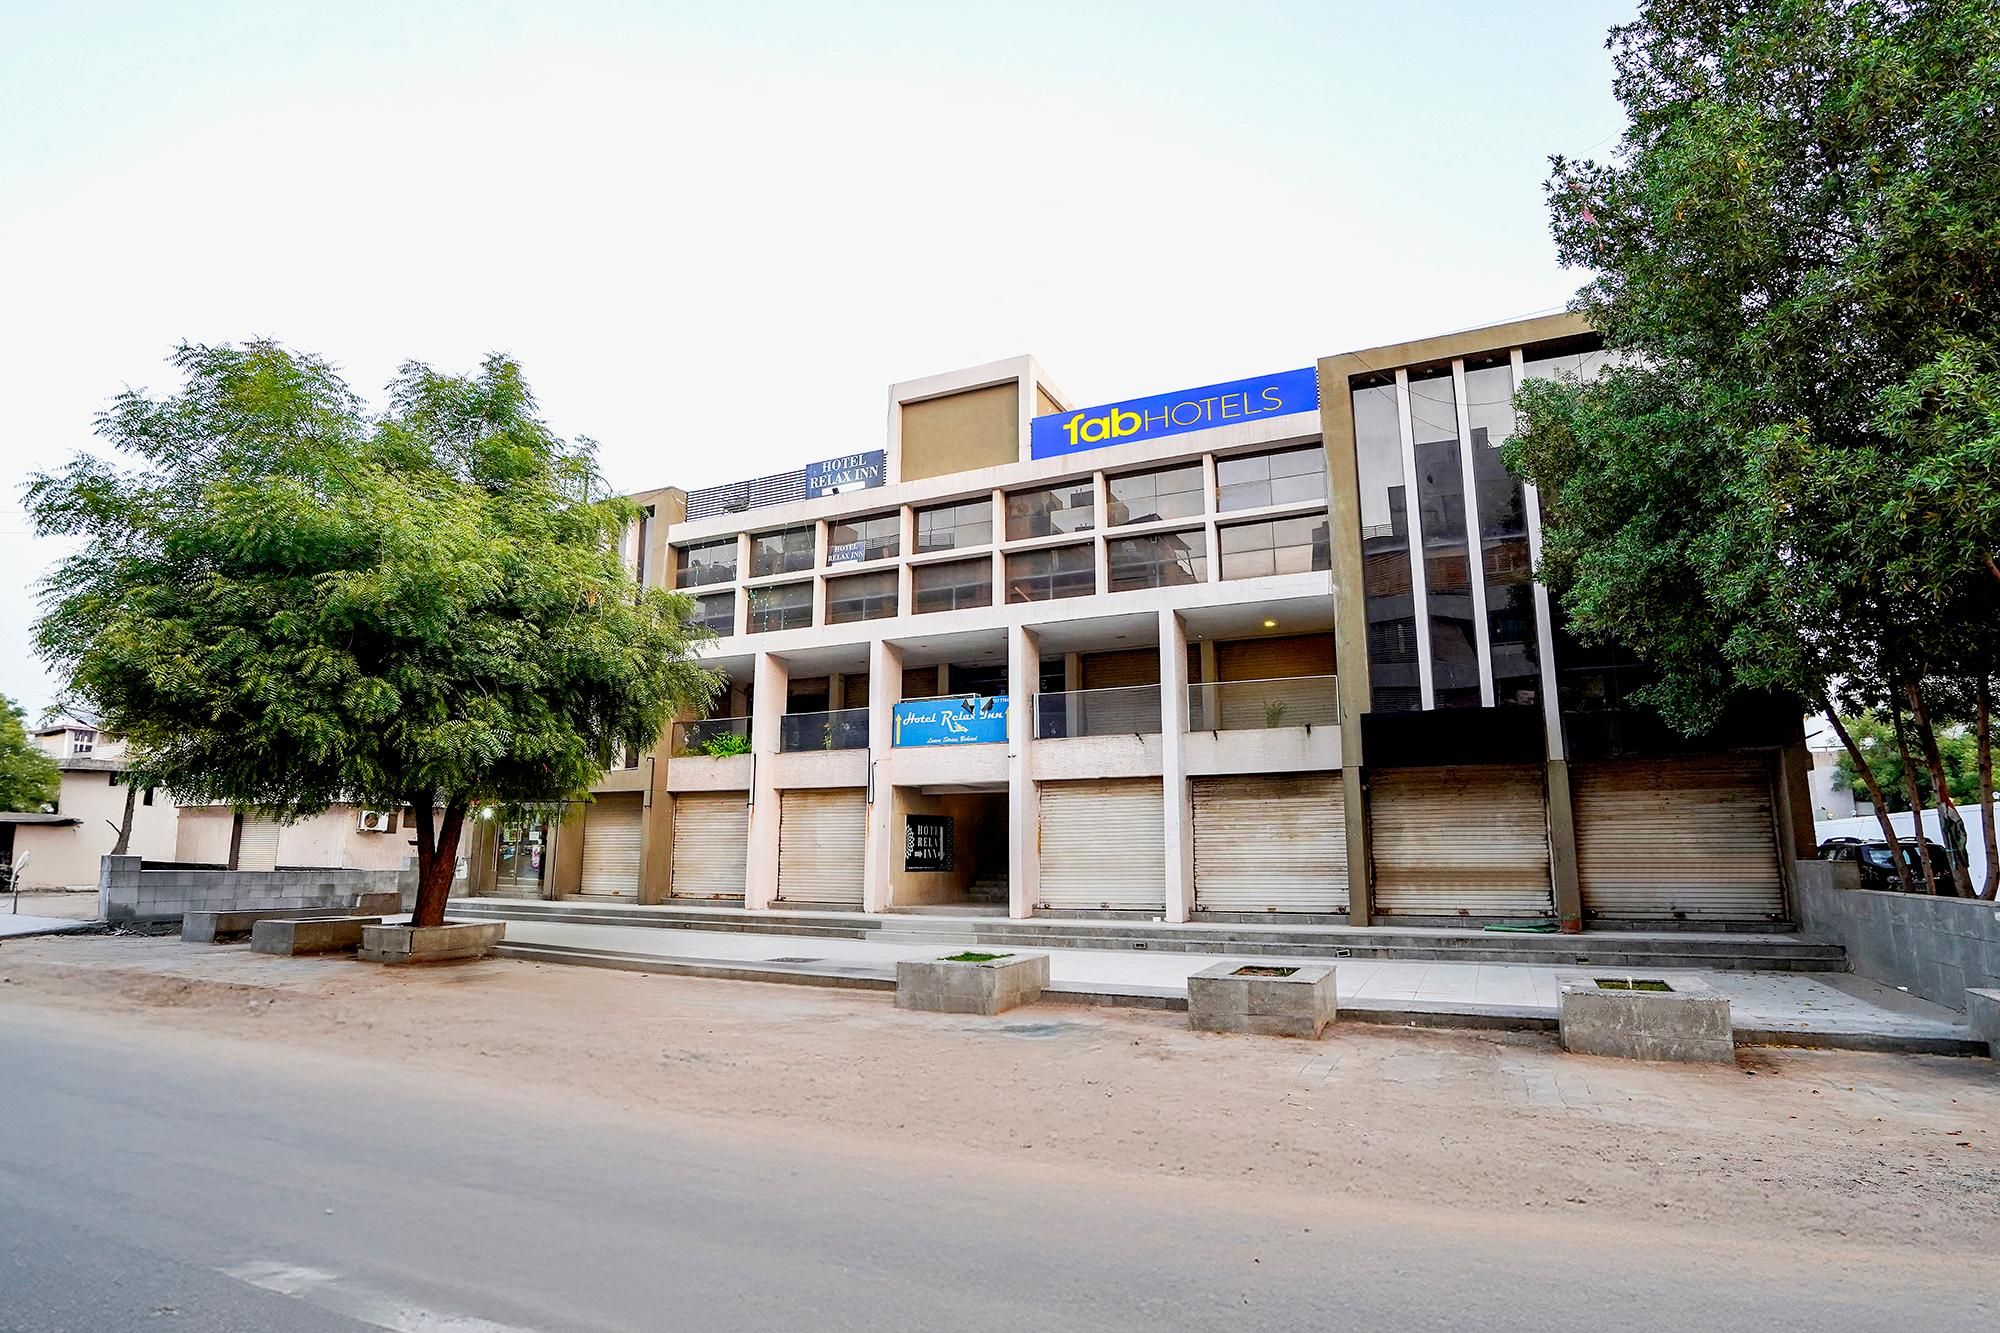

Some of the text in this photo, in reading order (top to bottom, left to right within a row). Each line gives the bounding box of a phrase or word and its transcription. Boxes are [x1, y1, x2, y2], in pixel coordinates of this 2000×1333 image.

[1063, 387, 1283, 445] fabHOTELS
[822, 454, 867, 473] HOTEL
[810, 465, 879, 489] RELAX INN
[828, 550, 864, 561] RELAX INN
[834, 543, 858, 553] HOTEL
[903, 710, 1004, 732] Hotel Relax Inn
[917, 824, 938, 836] HOTE
[923, 848, 937, 858] INN
